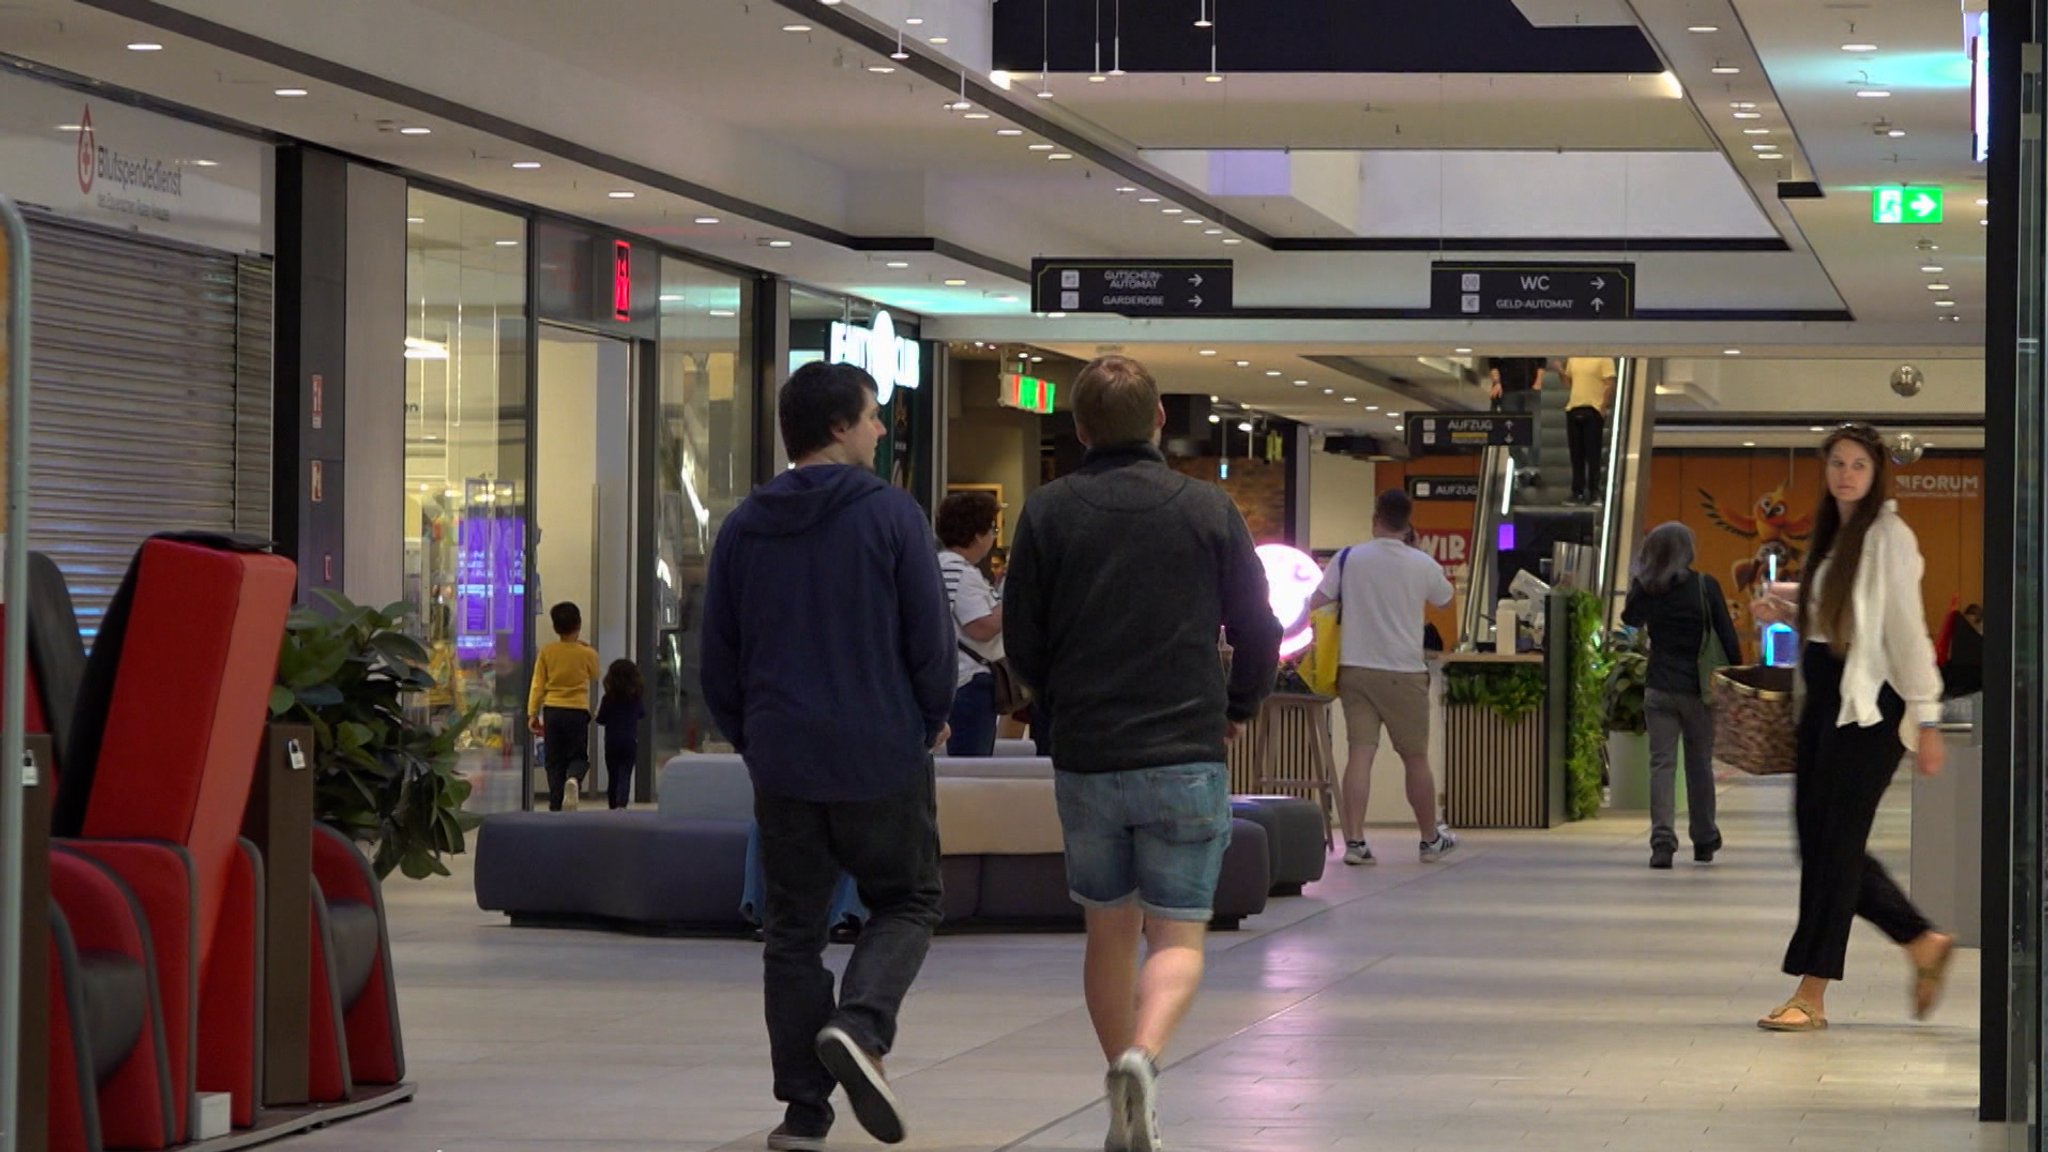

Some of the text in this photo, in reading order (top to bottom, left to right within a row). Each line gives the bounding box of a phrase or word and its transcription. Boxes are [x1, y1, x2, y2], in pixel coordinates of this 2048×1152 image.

[97, 145, 182, 196] Blutspendedienst
[1104, 270, 1163, 280] GUTSCHEIN-
[1109, 279, 1157, 289] AUTOMAT
[1520, 275, 1550, 290] WC
[1102, 295, 1164, 306] GARDEROBE
[1496, 299, 1574, 309] GELD-AUTOMAT
[1447, 419, 1494, 431] AUFZUG
[1911, 475, 1979, 490] FORUM
[1418, 534, 1466, 561] WIR
